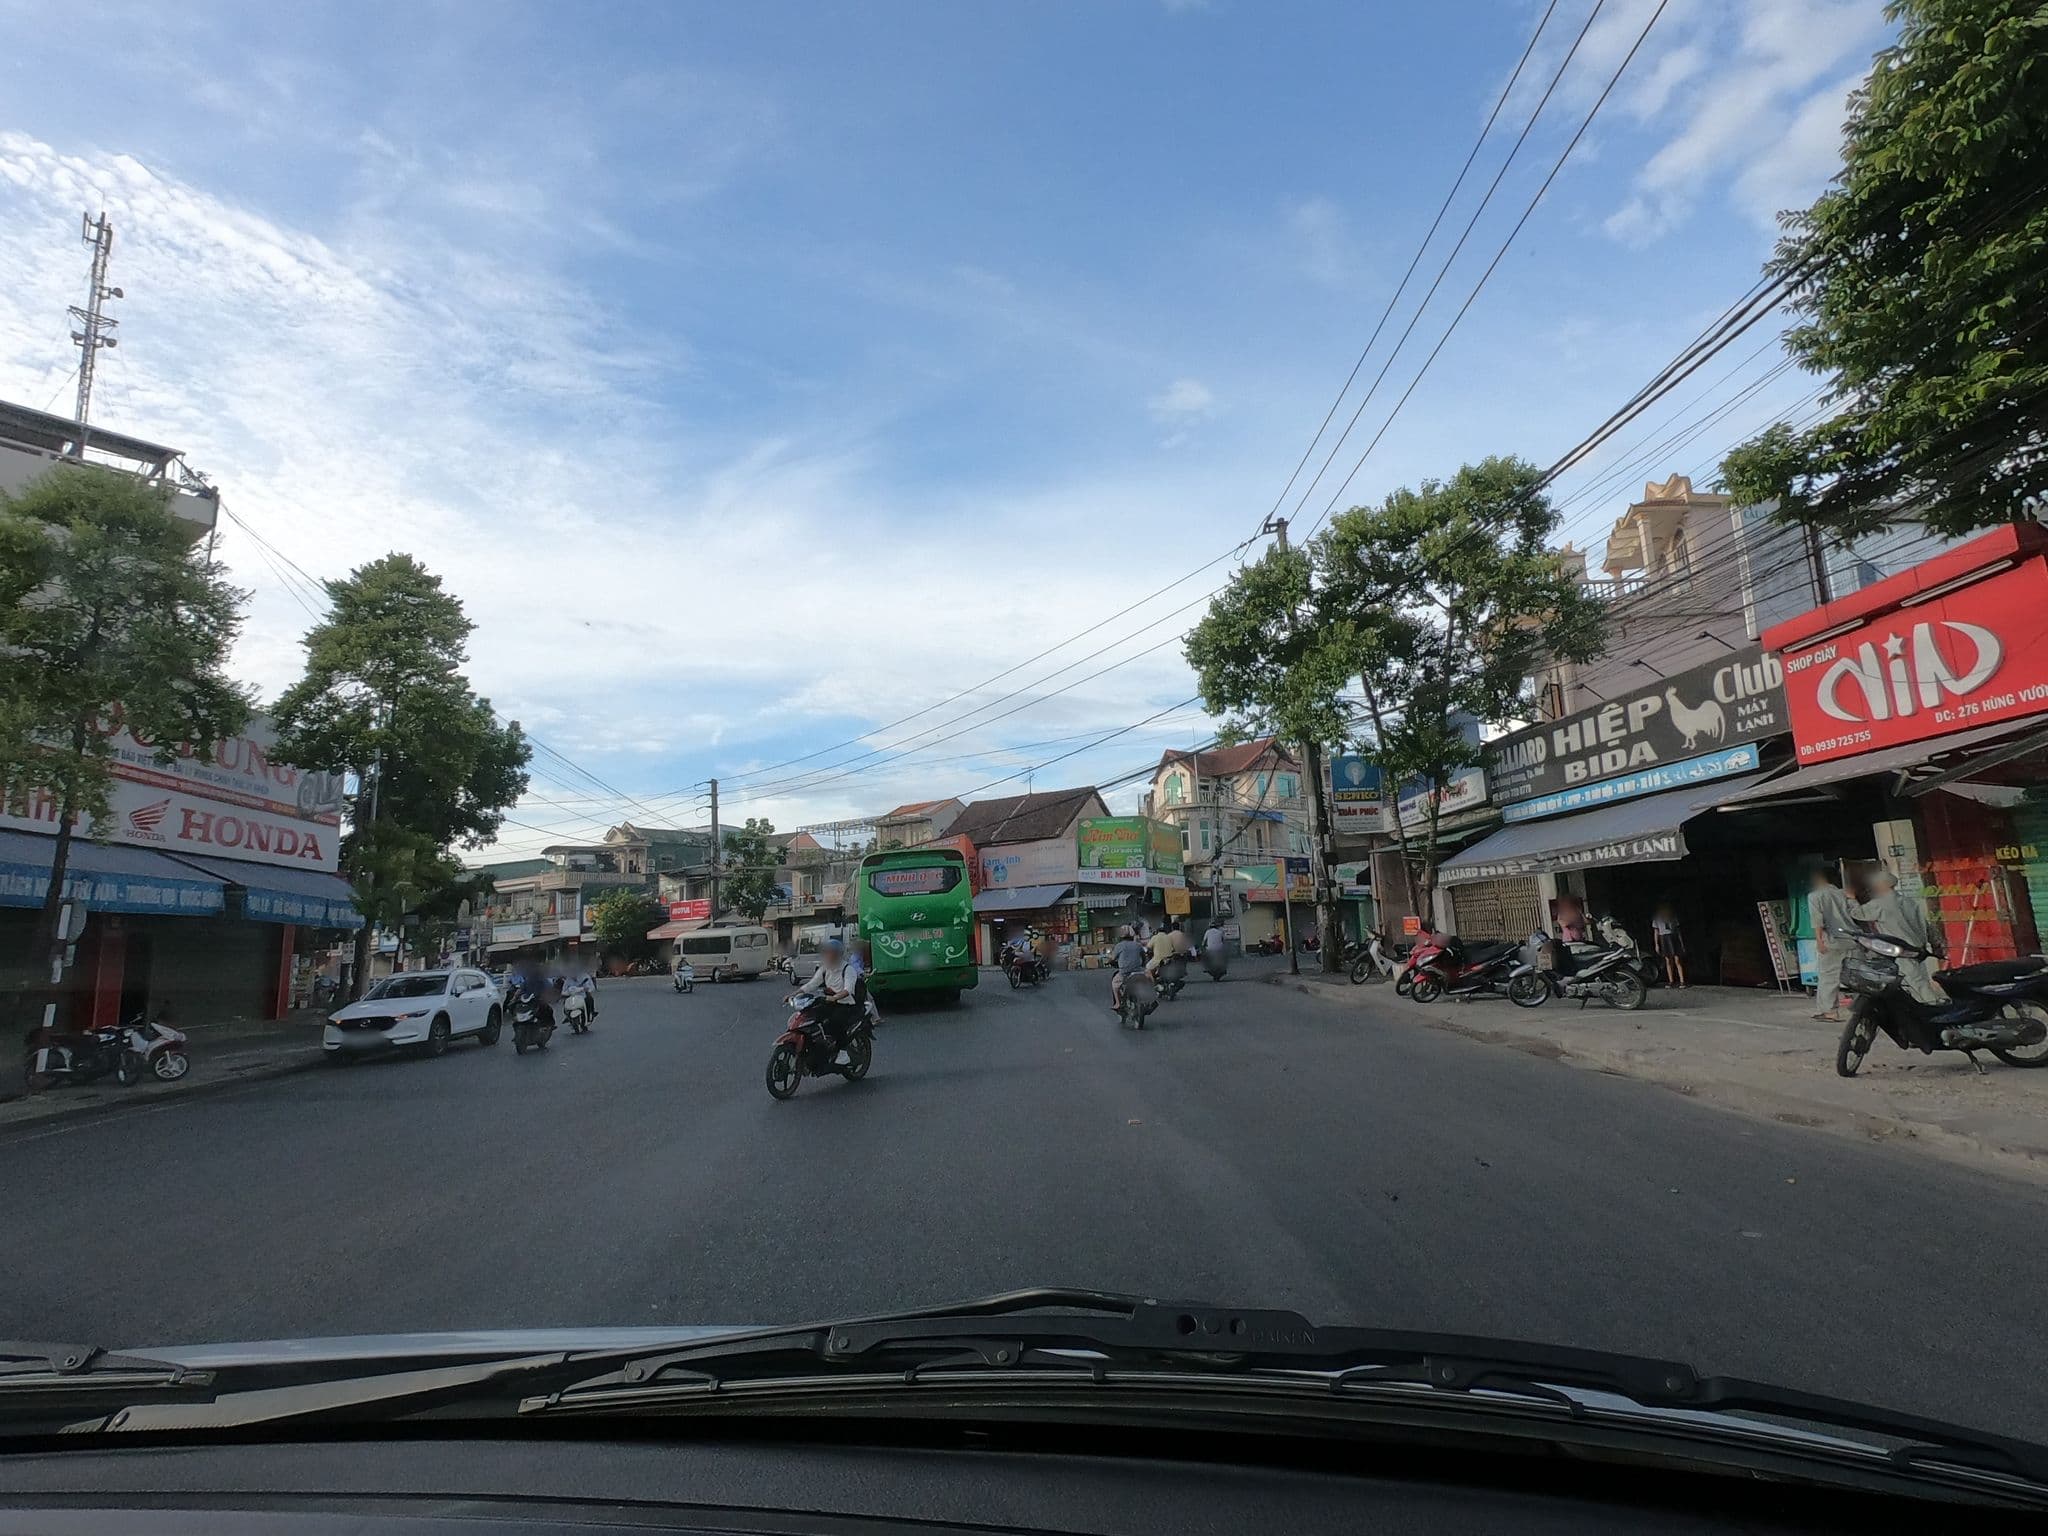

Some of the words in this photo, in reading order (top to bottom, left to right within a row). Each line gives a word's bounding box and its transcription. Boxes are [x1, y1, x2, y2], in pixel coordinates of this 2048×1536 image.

[1787, 655, 1813, 674] SHOP
[1713, 652, 1784, 704] Club
[1737, 697, 1770, 717] MÁY
[1958, 702, 1980, 718] 276
[1553, 696, 1664, 757] HIỆP
[1736, 714, 1776, 734] LẠNH
[1564, 741, 1659, 784] BIDA
[125, 829, 167, 843] HONDA
[177, 807, 324, 861] HONDA
